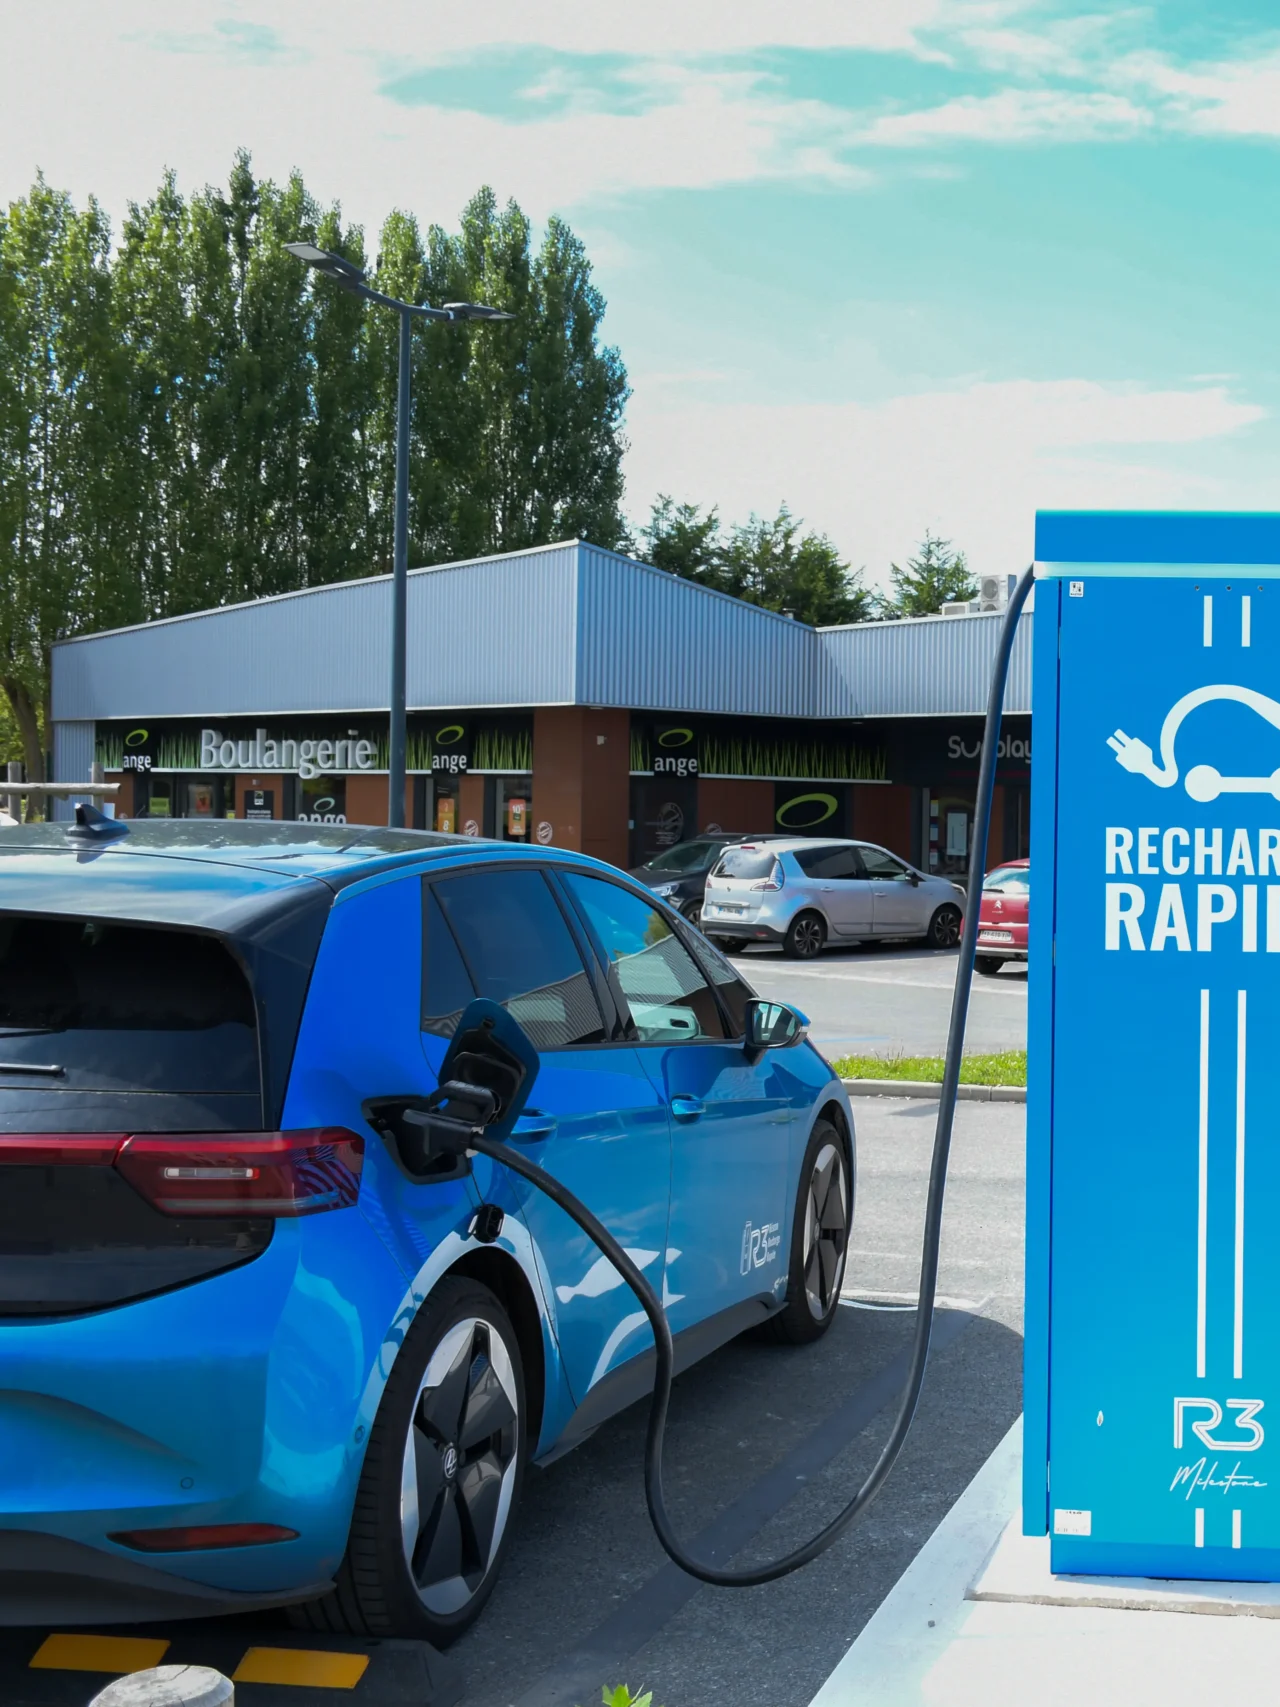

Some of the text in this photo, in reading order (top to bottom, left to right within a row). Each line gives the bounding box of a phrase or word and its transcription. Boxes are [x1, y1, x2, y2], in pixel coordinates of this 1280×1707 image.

[123, 754, 151, 772] ange
[201, 729, 376, 779] Boulangerie
[432, 754, 467, 774] ange
[654, 757, 698, 777] ange
[1174, 1397, 1265, 1451] R3
[1170, 1457, 1267, 1500] Milestone
